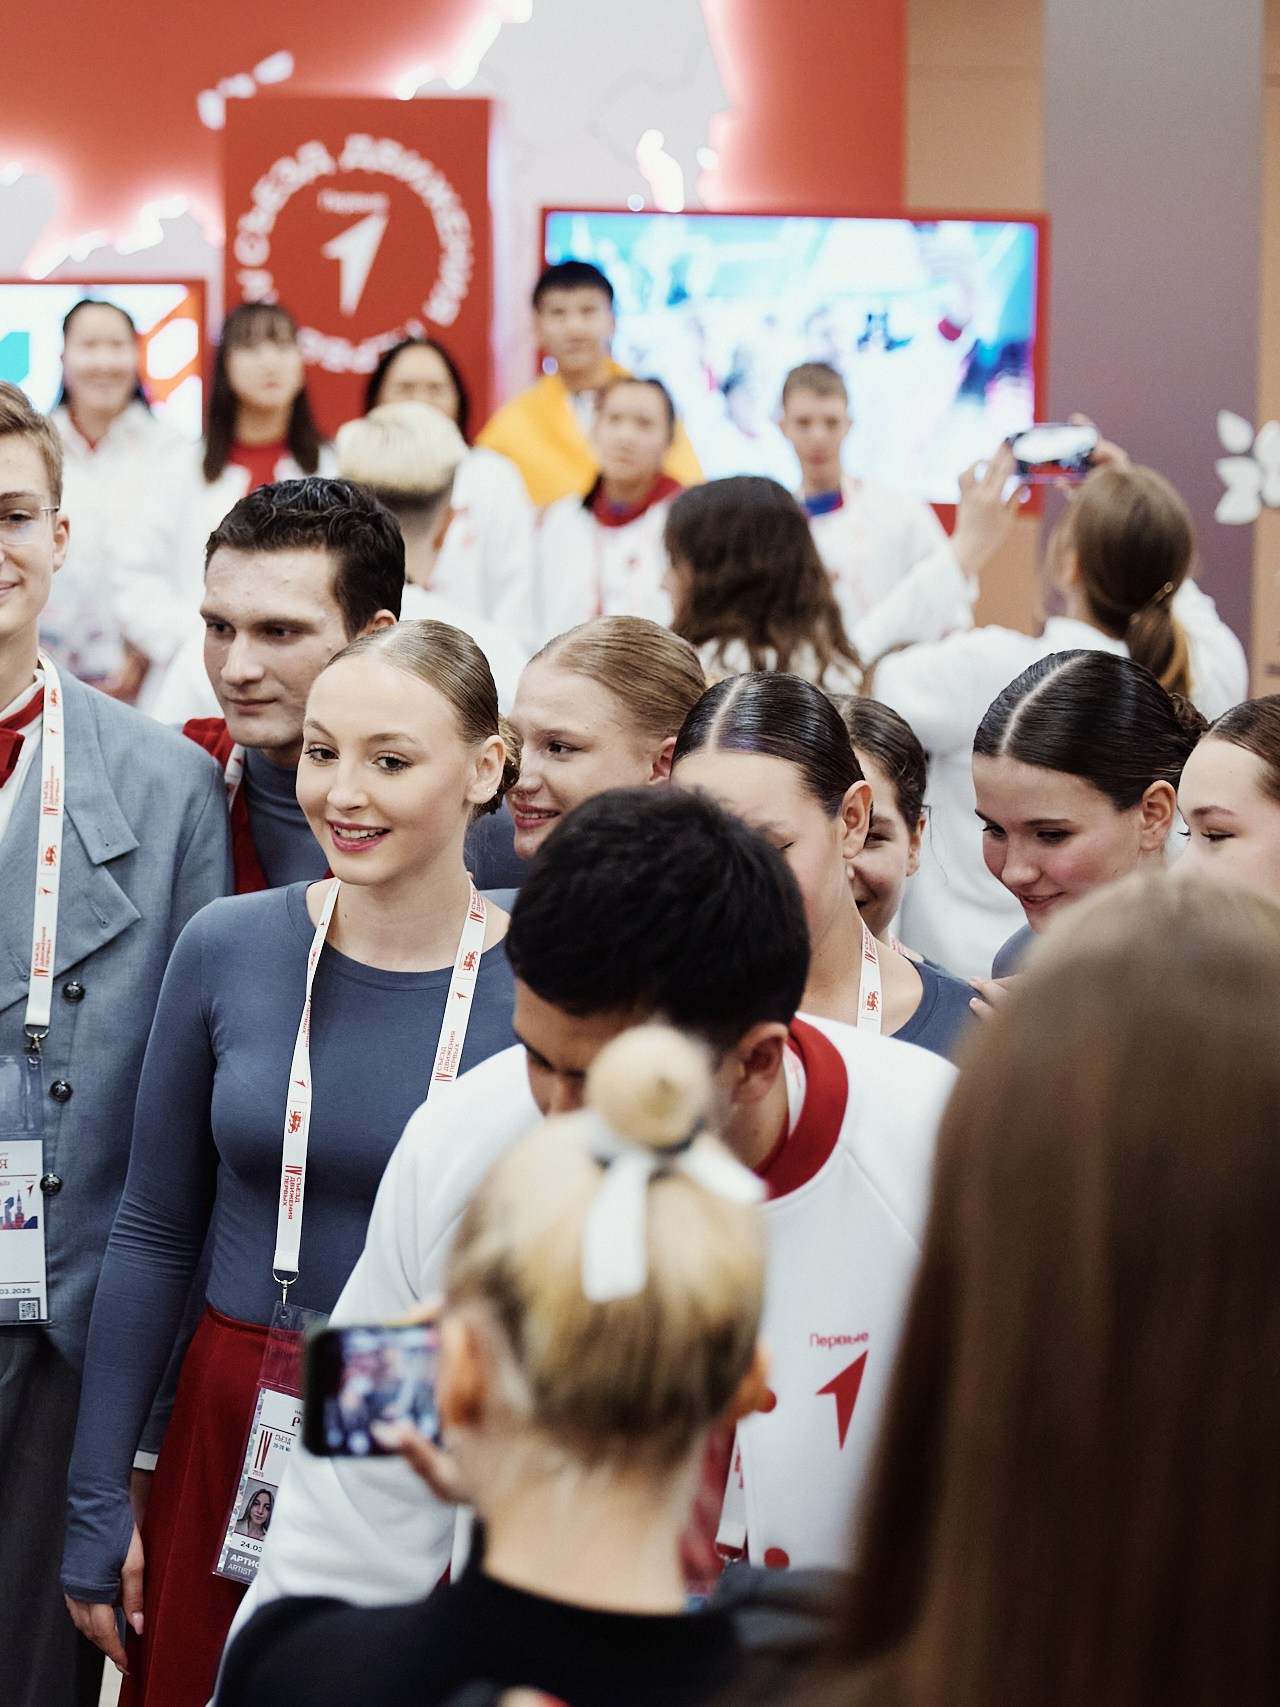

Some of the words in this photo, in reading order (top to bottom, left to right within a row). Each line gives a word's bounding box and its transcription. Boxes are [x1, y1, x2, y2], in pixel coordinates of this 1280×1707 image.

[470, 910, 484, 924] IV
[865, 951, 877, 965] IV
[437, 1046, 447, 1071] СЪЕЗД
[444, 1031, 456, 1072] ДВИЖЕНИЯ
[450, 1044, 460, 1073] ПЕРВЫХ
[435, 1072, 453, 1082] IV
[285, 1165, 303, 1176] IV
[809, 1332, 869, 1350] Первые
[274, 1434, 292, 1446] СЪЕЗД
[254, 1430, 273, 1470] IV
[230, 1554, 260, 1568] АРТИС
[228, 1563, 252, 1575] ARTIST
